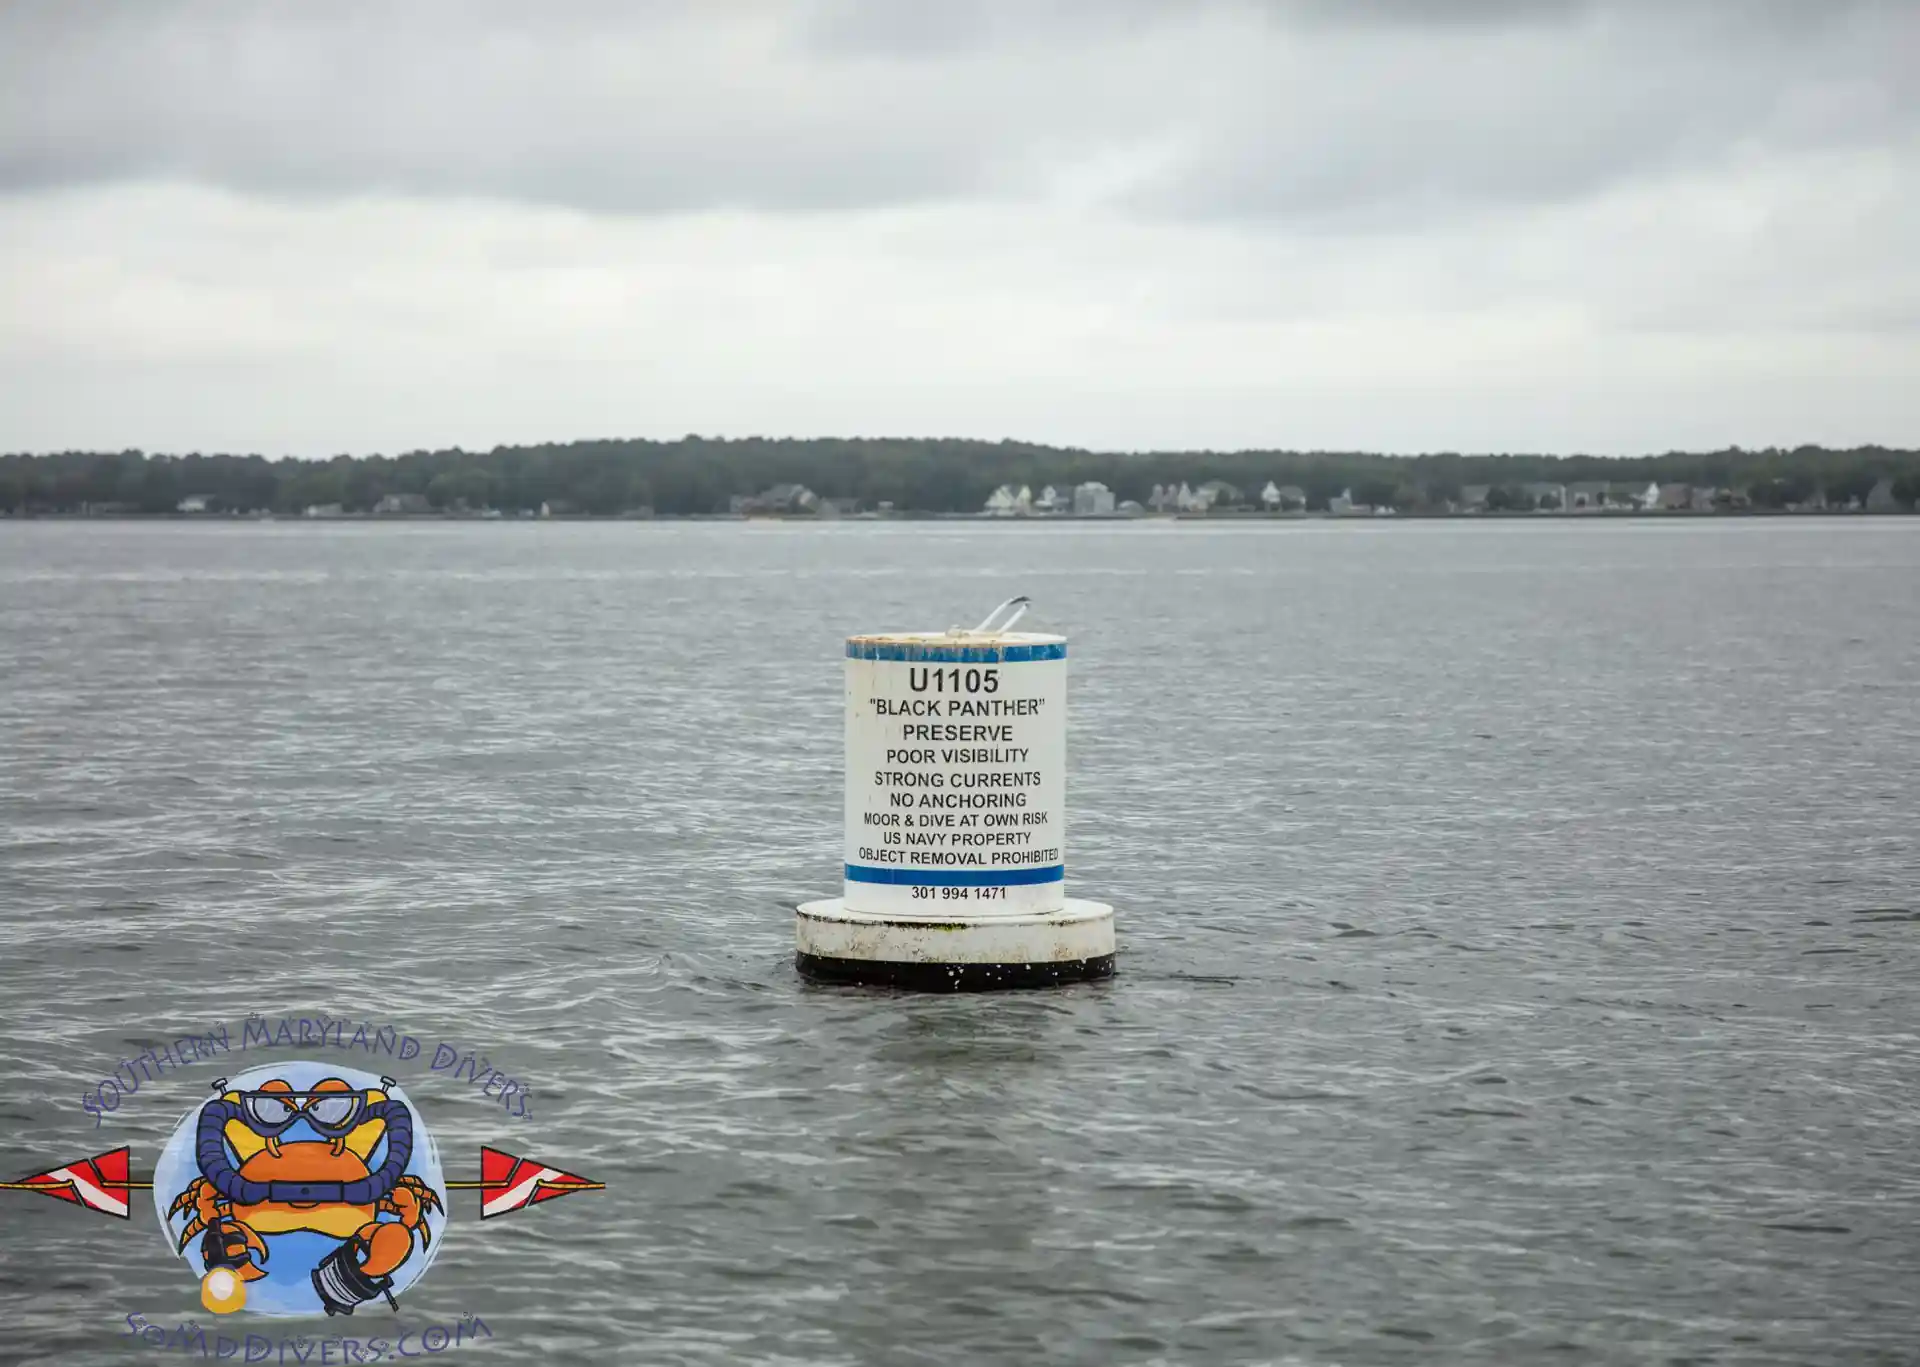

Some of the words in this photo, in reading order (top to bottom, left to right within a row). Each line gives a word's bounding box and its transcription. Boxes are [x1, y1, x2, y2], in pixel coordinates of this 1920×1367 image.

[909, 667, 999, 694] U1105
[903, 724, 1013, 742] PRESERVE
[886, 749, 936, 765] POOR
[940, 748, 1029, 764] VISIBILITY
[874, 771, 944, 788] STRONG
[950, 771, 1041, 788] CURRENTS
[890, 792, 915, 808] NO
[918, 792, 1027, 809] ANCHORING
[864, 812, 901, 827] MOOR
[904, 814, 915, 827] &
[919, 813, 956, 828] DIVE
[959, 814, 980, 827] AT
[983, 813, 1019, 827] OWN
[1022, 811, 1048, 825] RISK
[883, 831, 901, 845] US
[905, 832, 947, 846] NAVY
[951, 831, 1031, 847] PROPERTY
[858, 846, 907, 864] OBJECT
[910, 851, 988, 865] REMOVAL
[991, 847, 1059, 865] PROHIBITED
[911, 886, 936, 900] 301
[941, 887, 969, 900] 994
[974, 886, 1006, 900] 1471
